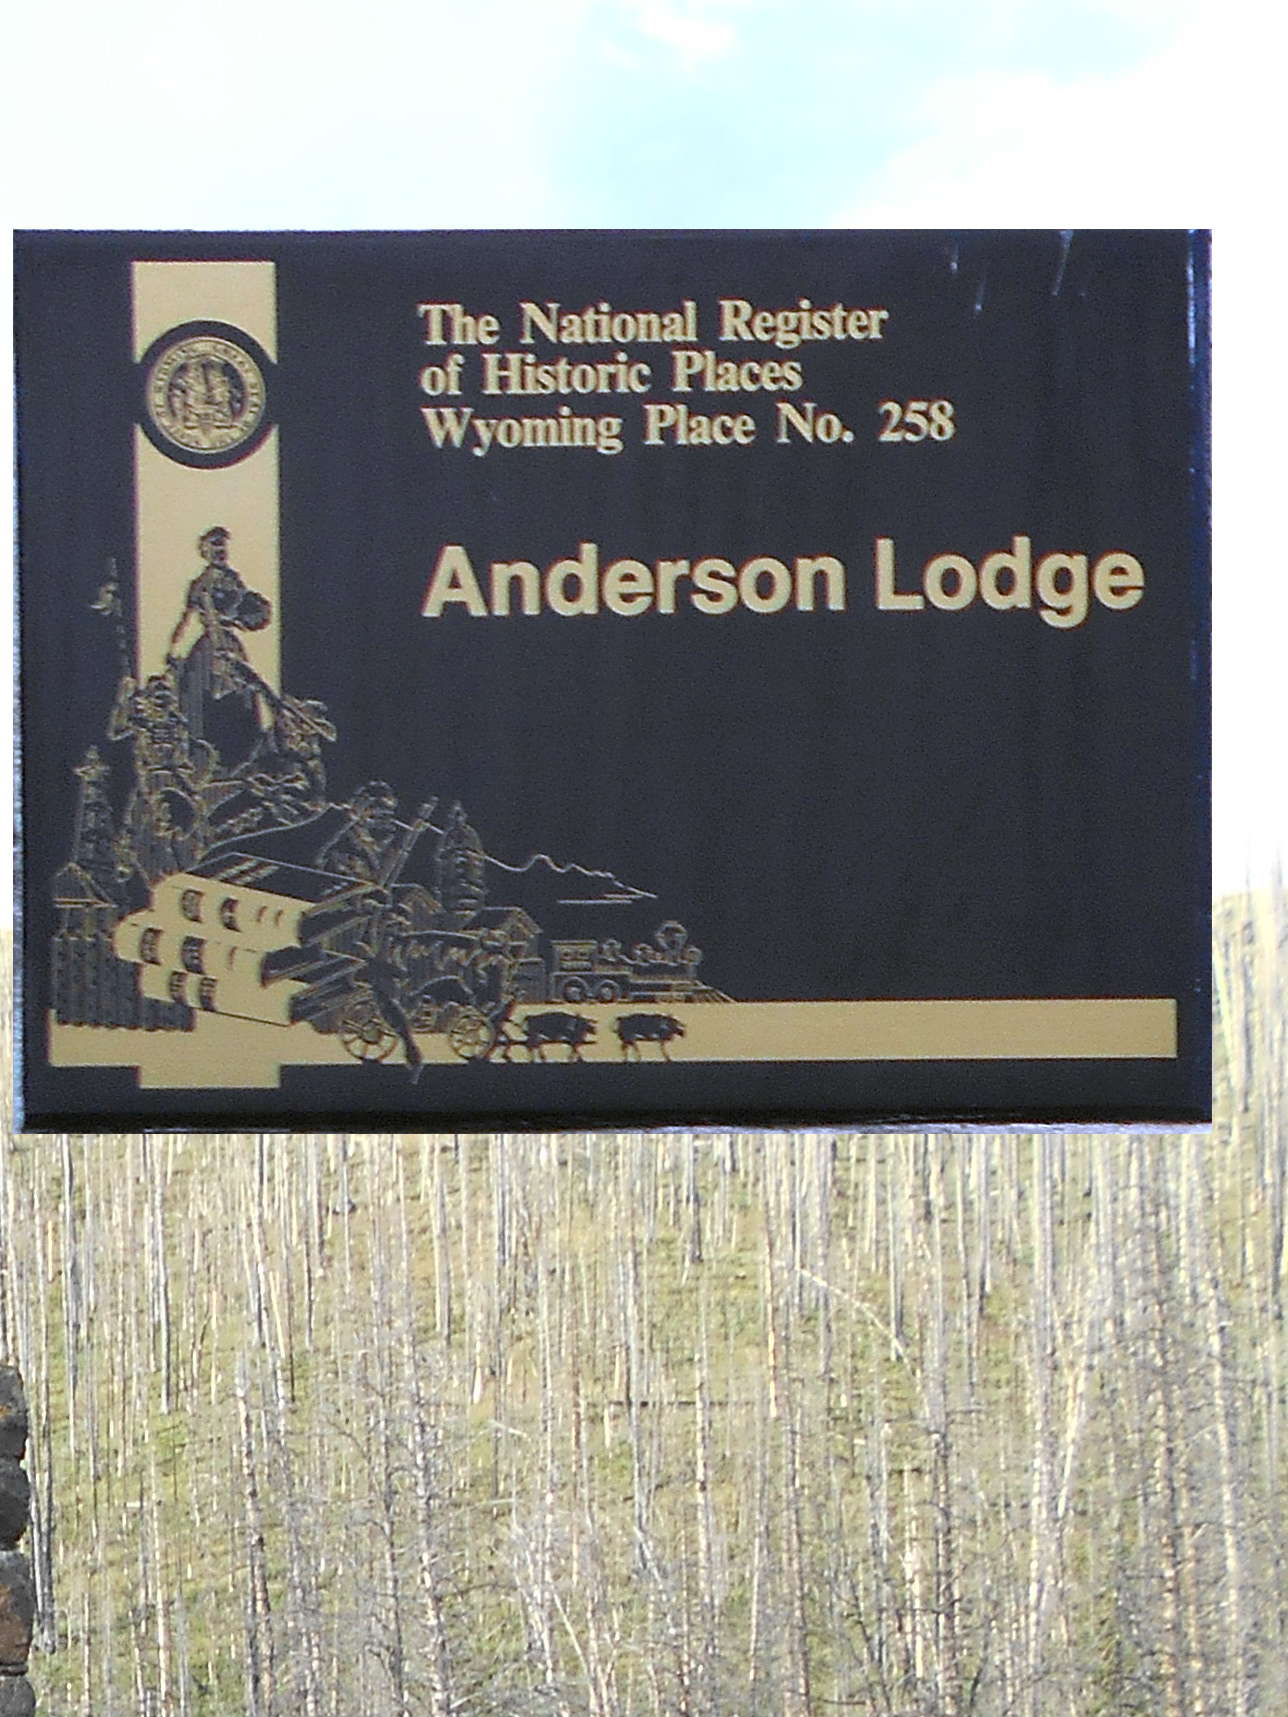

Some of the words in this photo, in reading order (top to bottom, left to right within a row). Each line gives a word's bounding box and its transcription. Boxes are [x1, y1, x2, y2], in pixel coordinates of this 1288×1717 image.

[418, 302, 500, 346] The
[520, 300, 697, 344] National
[719, 298, 890, 348] Register
[420, 353, 464, 395] of
[482, 351, 651, 395] Historic
[671, 349, 803, 392] Places
[422, 404, 624, 454] Wyoming
[643, 403, 755, 446] Place
[775, 401, 854, 444] No.
[878, 400, 956, 442] 258
[422, 541, 845, 617] Anderson
[874, 535, 1145, 629] Lodge
